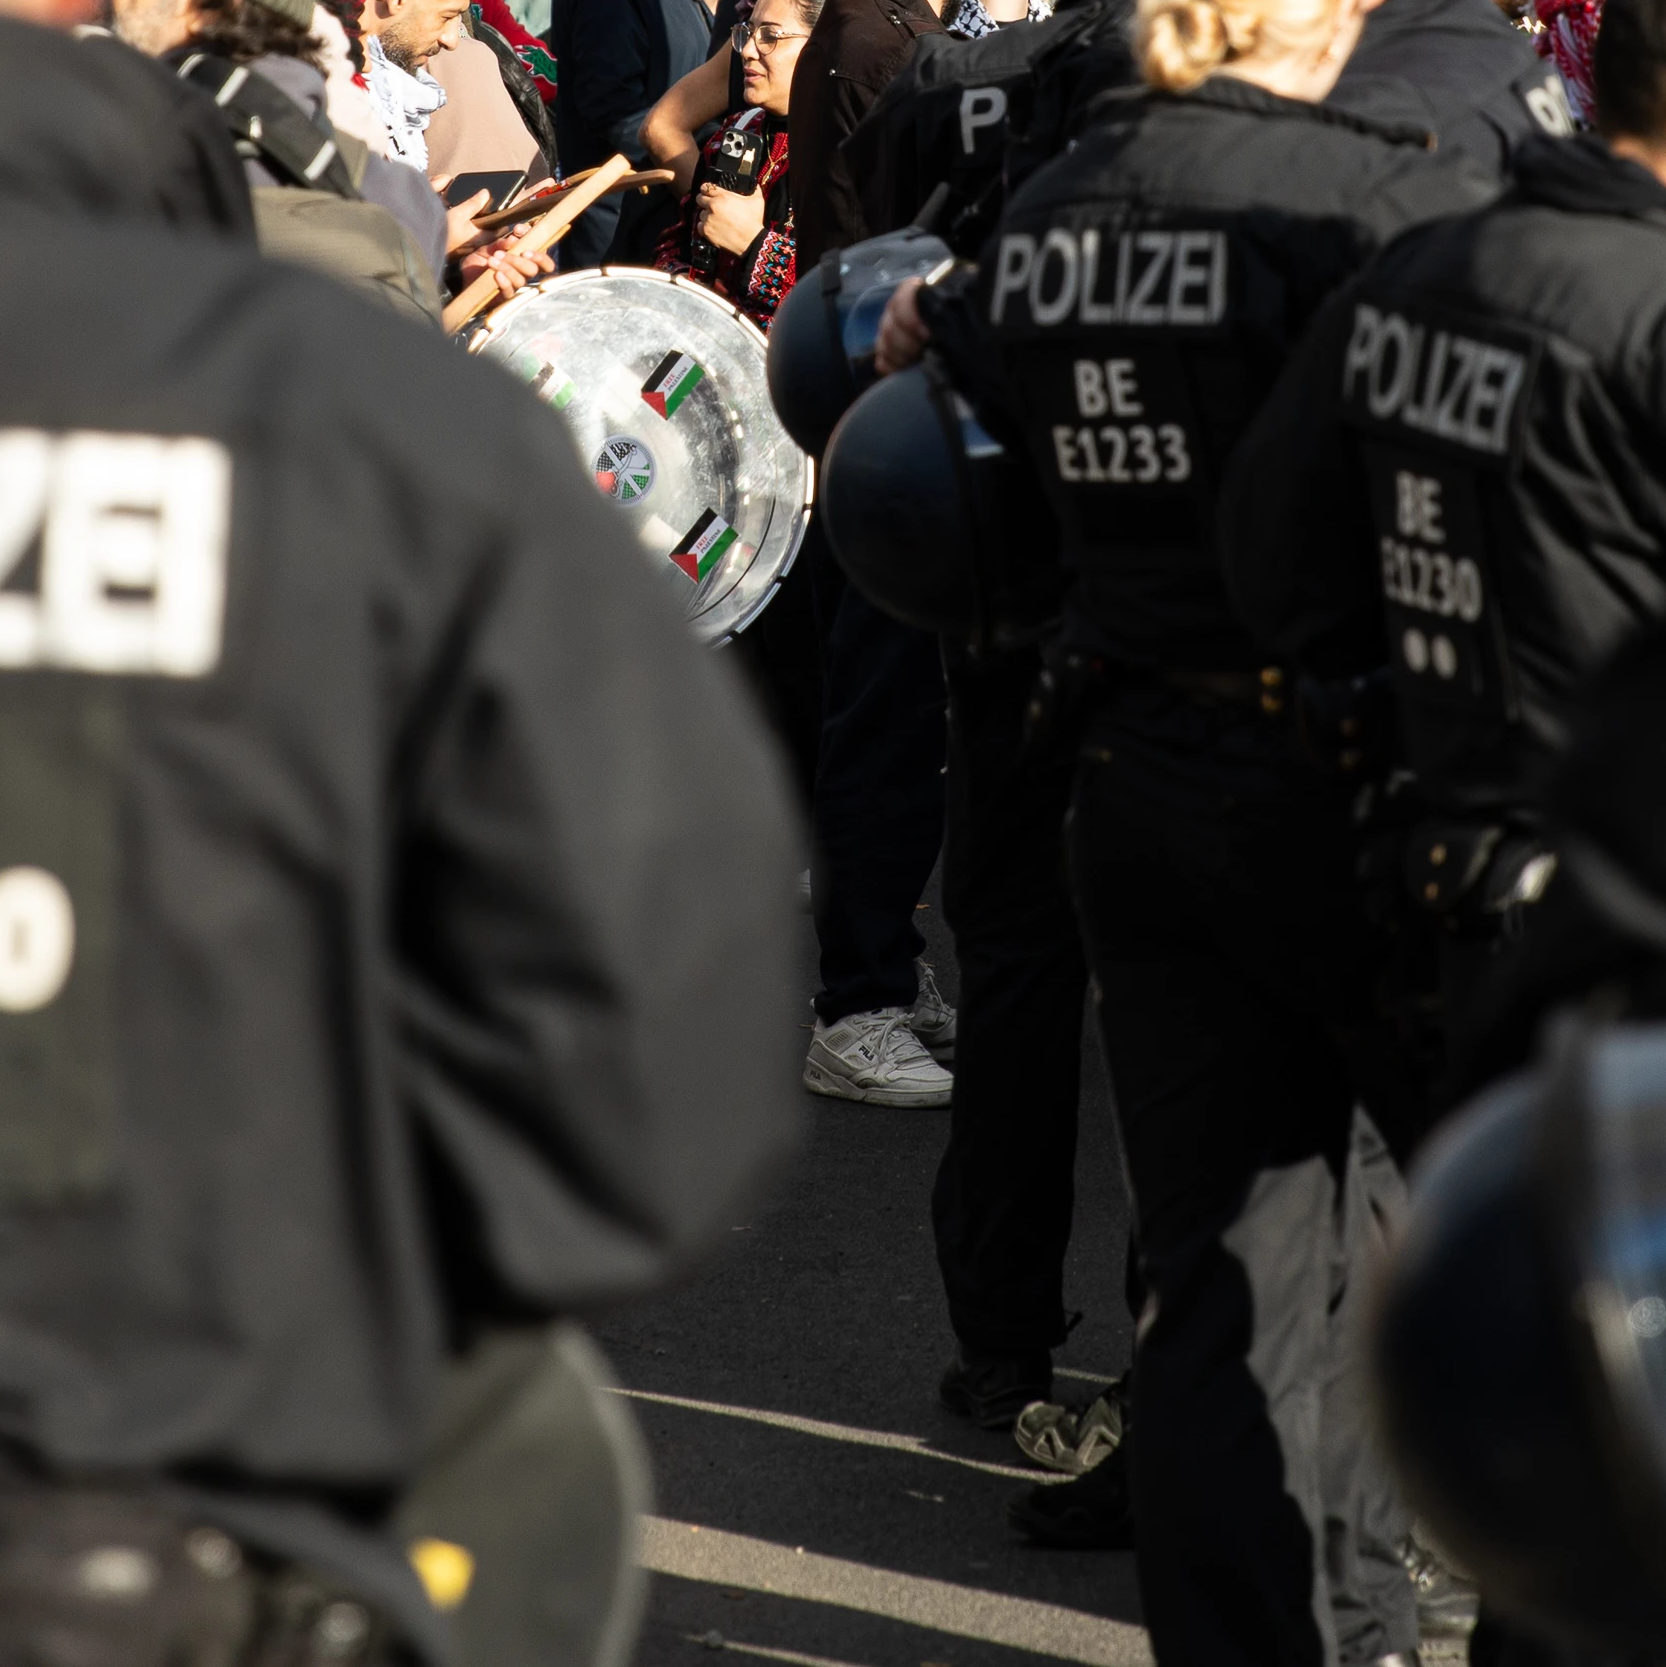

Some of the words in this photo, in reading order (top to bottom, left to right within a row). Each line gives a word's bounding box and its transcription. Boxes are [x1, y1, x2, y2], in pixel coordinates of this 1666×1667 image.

[990, 228, 1227, 326] POLIZEI
[1073, 359, 1143, 418] BE
[1343, 303, 1527, 455] POLIZEI
[1052, 424, 1192, 482] E1233
[1395, 470, 1446, 544] BE
[1380, 536, 1482, 622] E1230
[859, 1045, 875, 1061] FILA
